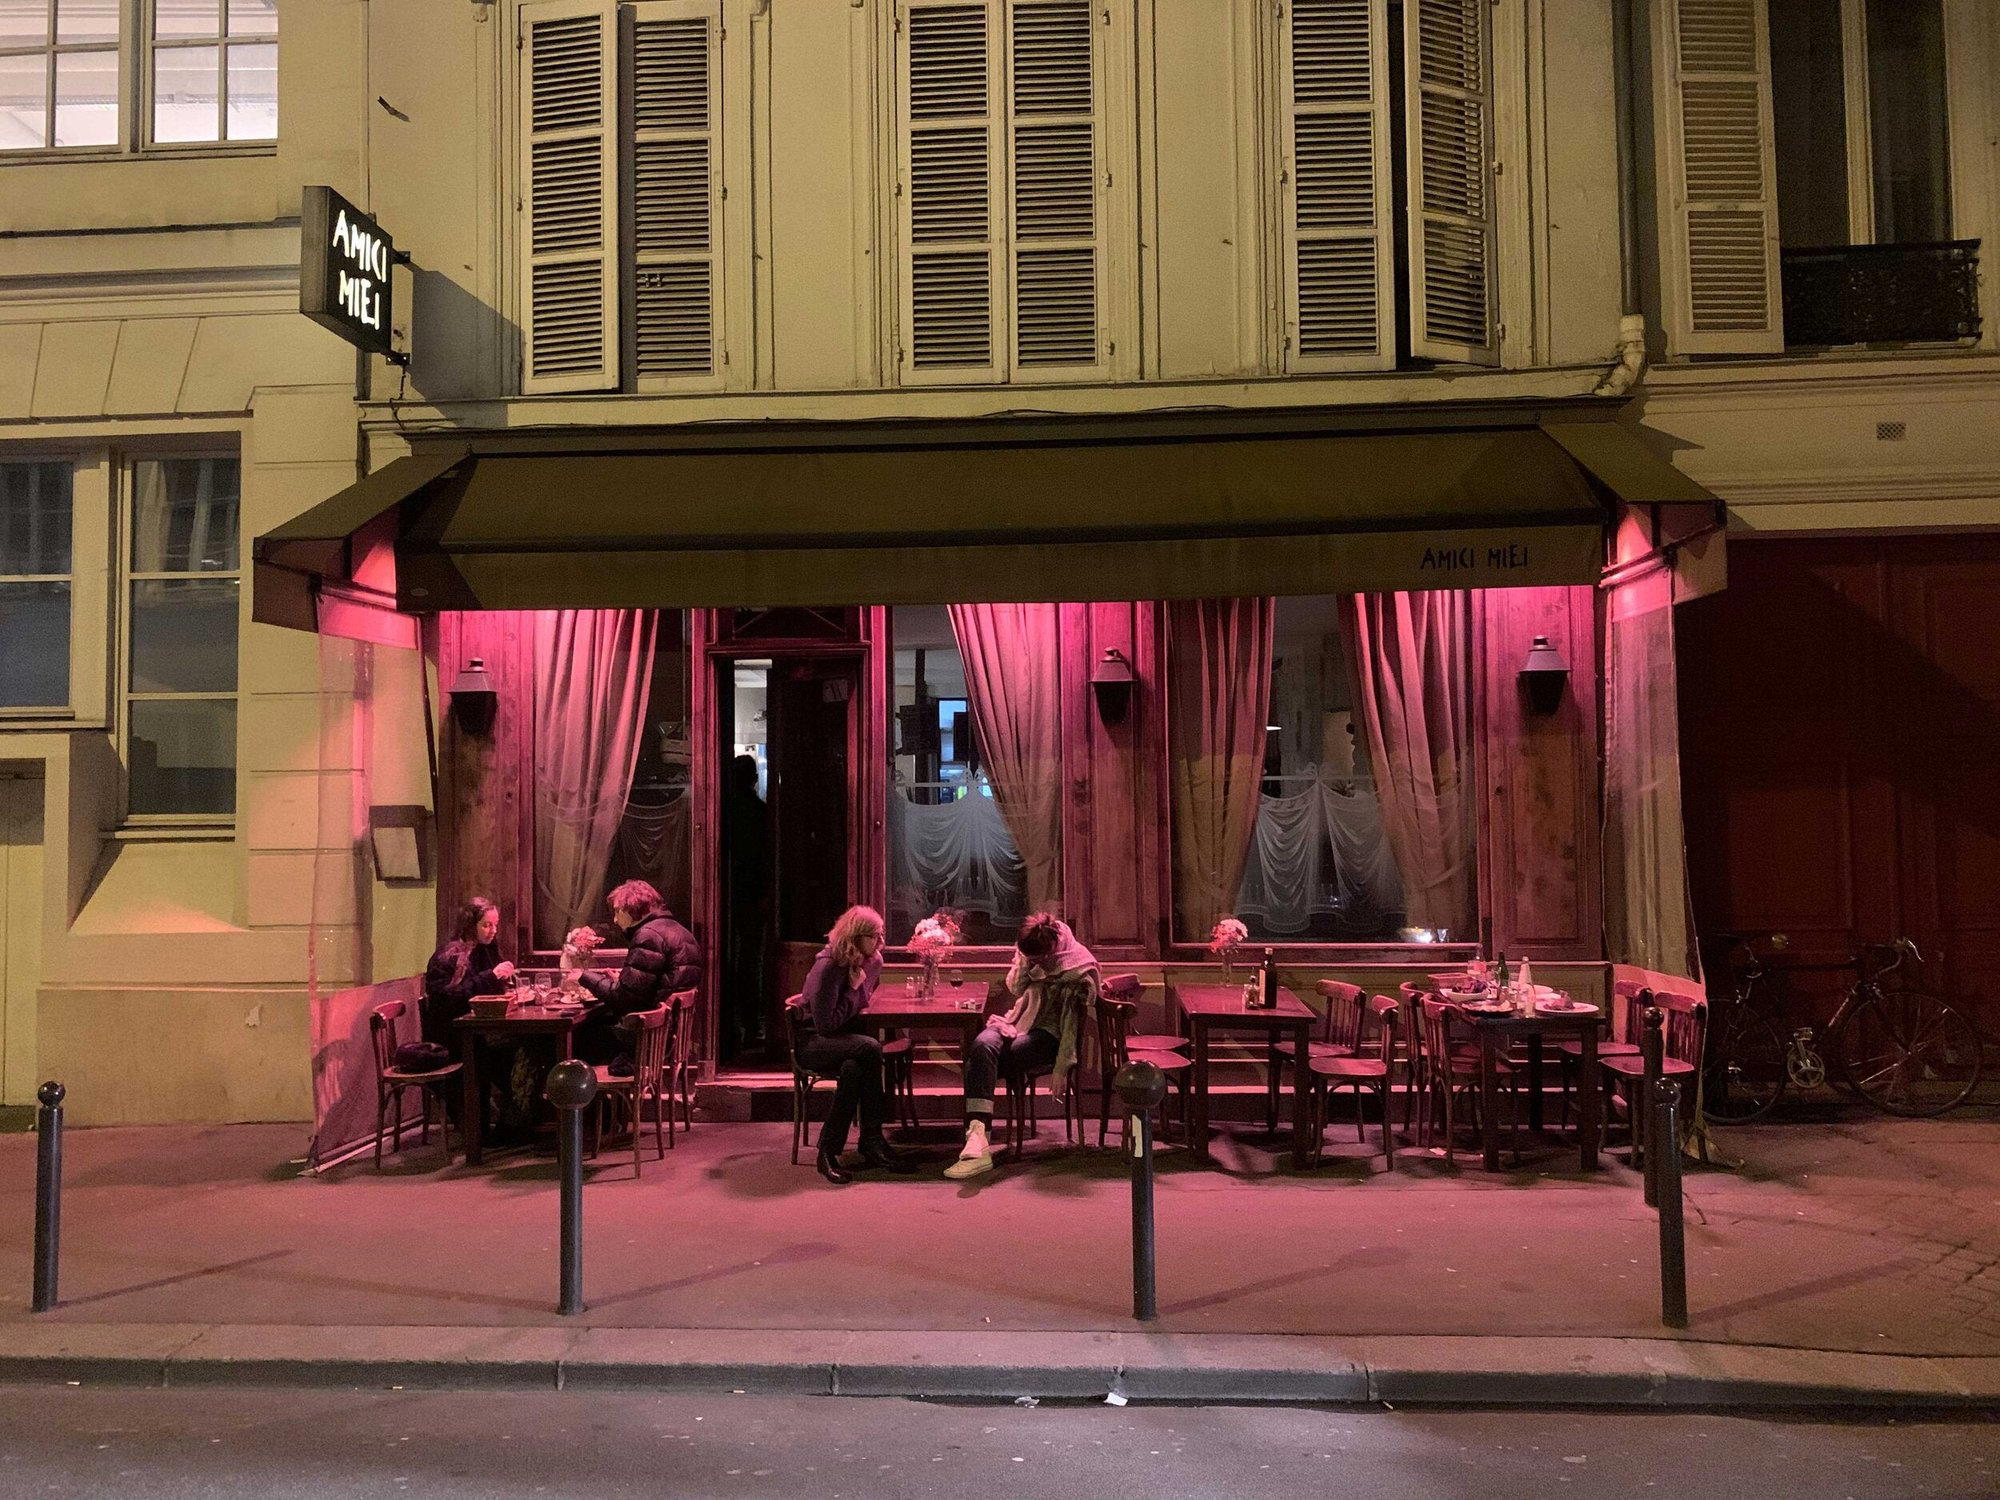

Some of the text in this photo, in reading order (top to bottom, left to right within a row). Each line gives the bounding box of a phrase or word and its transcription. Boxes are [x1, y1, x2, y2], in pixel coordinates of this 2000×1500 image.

[333, 209, 387, 283] AMICI
[338, 269, 380, 331] MIEI
[1420, 543, 1529, 571] AMICI MIEI
